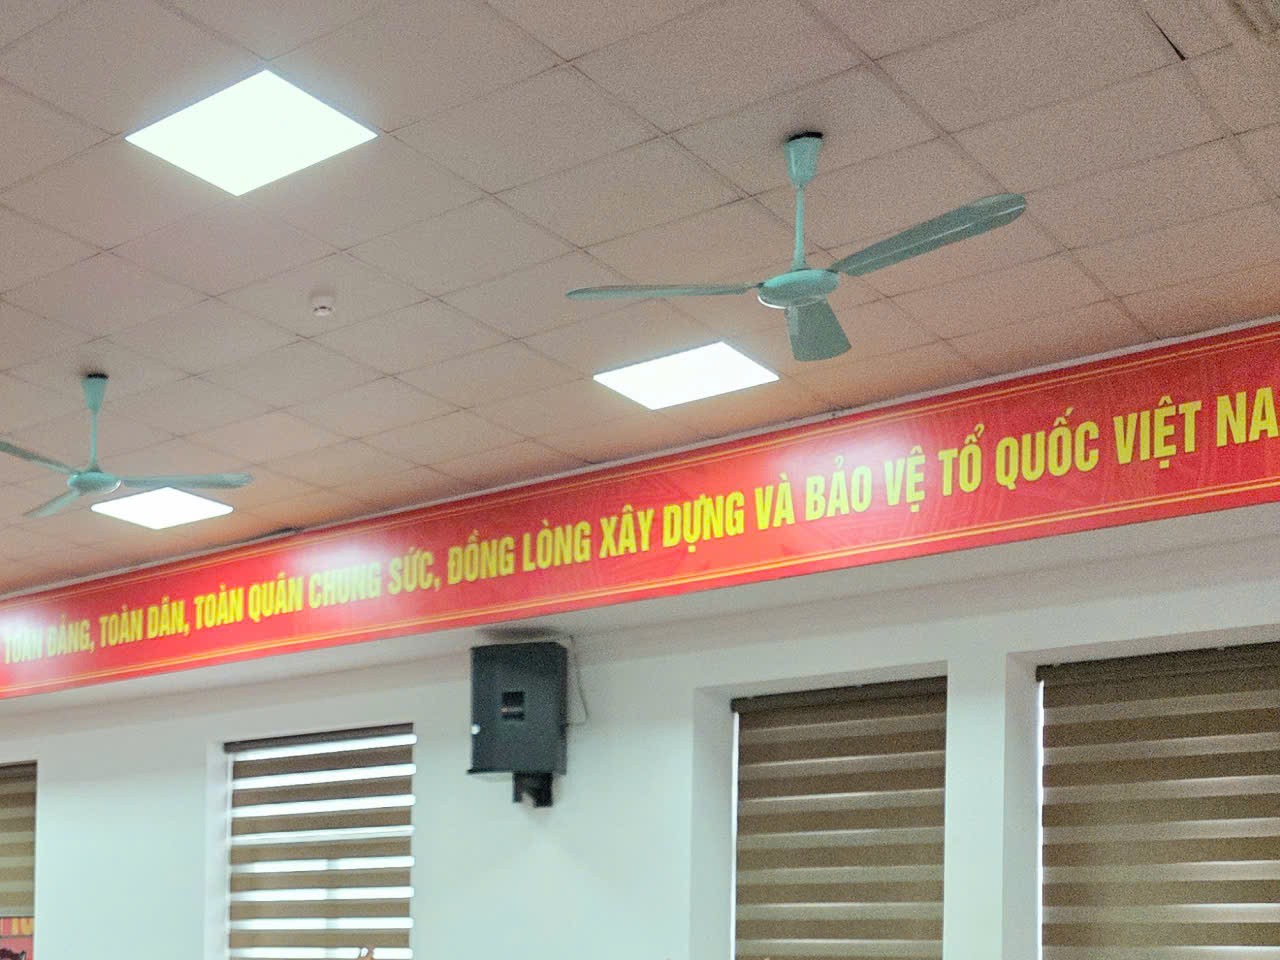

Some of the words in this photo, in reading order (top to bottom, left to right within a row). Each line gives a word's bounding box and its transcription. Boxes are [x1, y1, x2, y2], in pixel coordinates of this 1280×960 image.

[100, 604, 143, 647] TOÀN
[147, 597, 189, 636] DÂN,
[194, 584, 243, 630] TOÀN
[248, 571, 303, 623] QUÂN
[308, 561, 382, 609] CHUNG
[388, 547, 440, 591] SỨC,
[448, 528, 515, 584] ĐỒNG
[523, 519, 591, 572] LÒNG
[599, 504, 655, 559] XÂY
[662, 491, 744, 552] DỰNG
[755, 472, 795, 531] VÀ
[805, 455, 872, 521] BẢO
[884, 445, 926, 513] VỆ
[938, 423, 985, 496] TỔ
[995, 407, 1099, 490] QUỐC
[1113, 395, 1202, 469] VIỆT
[1216, 386, 1279, 447] NA
